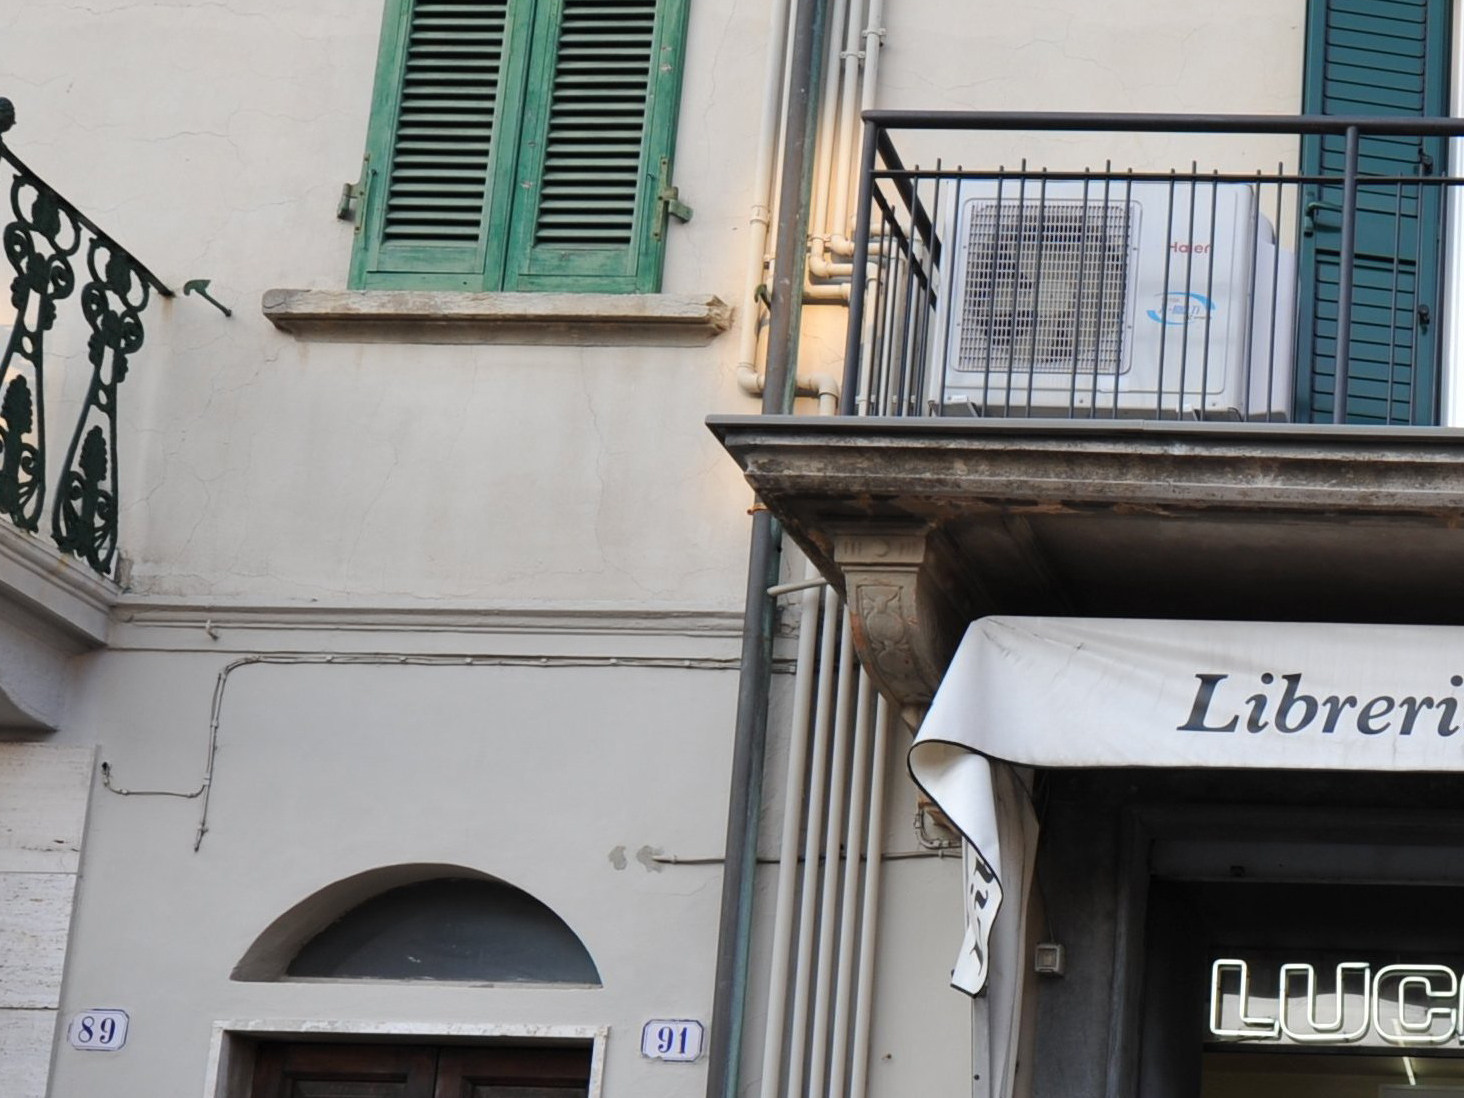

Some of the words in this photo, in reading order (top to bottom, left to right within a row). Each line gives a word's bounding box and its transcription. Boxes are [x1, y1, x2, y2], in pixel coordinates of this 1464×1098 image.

[1168, 241, 1212, 254] Haer
[78, 1016, 117, 1045] 89
[657, 1025, 690, 1054] 91
